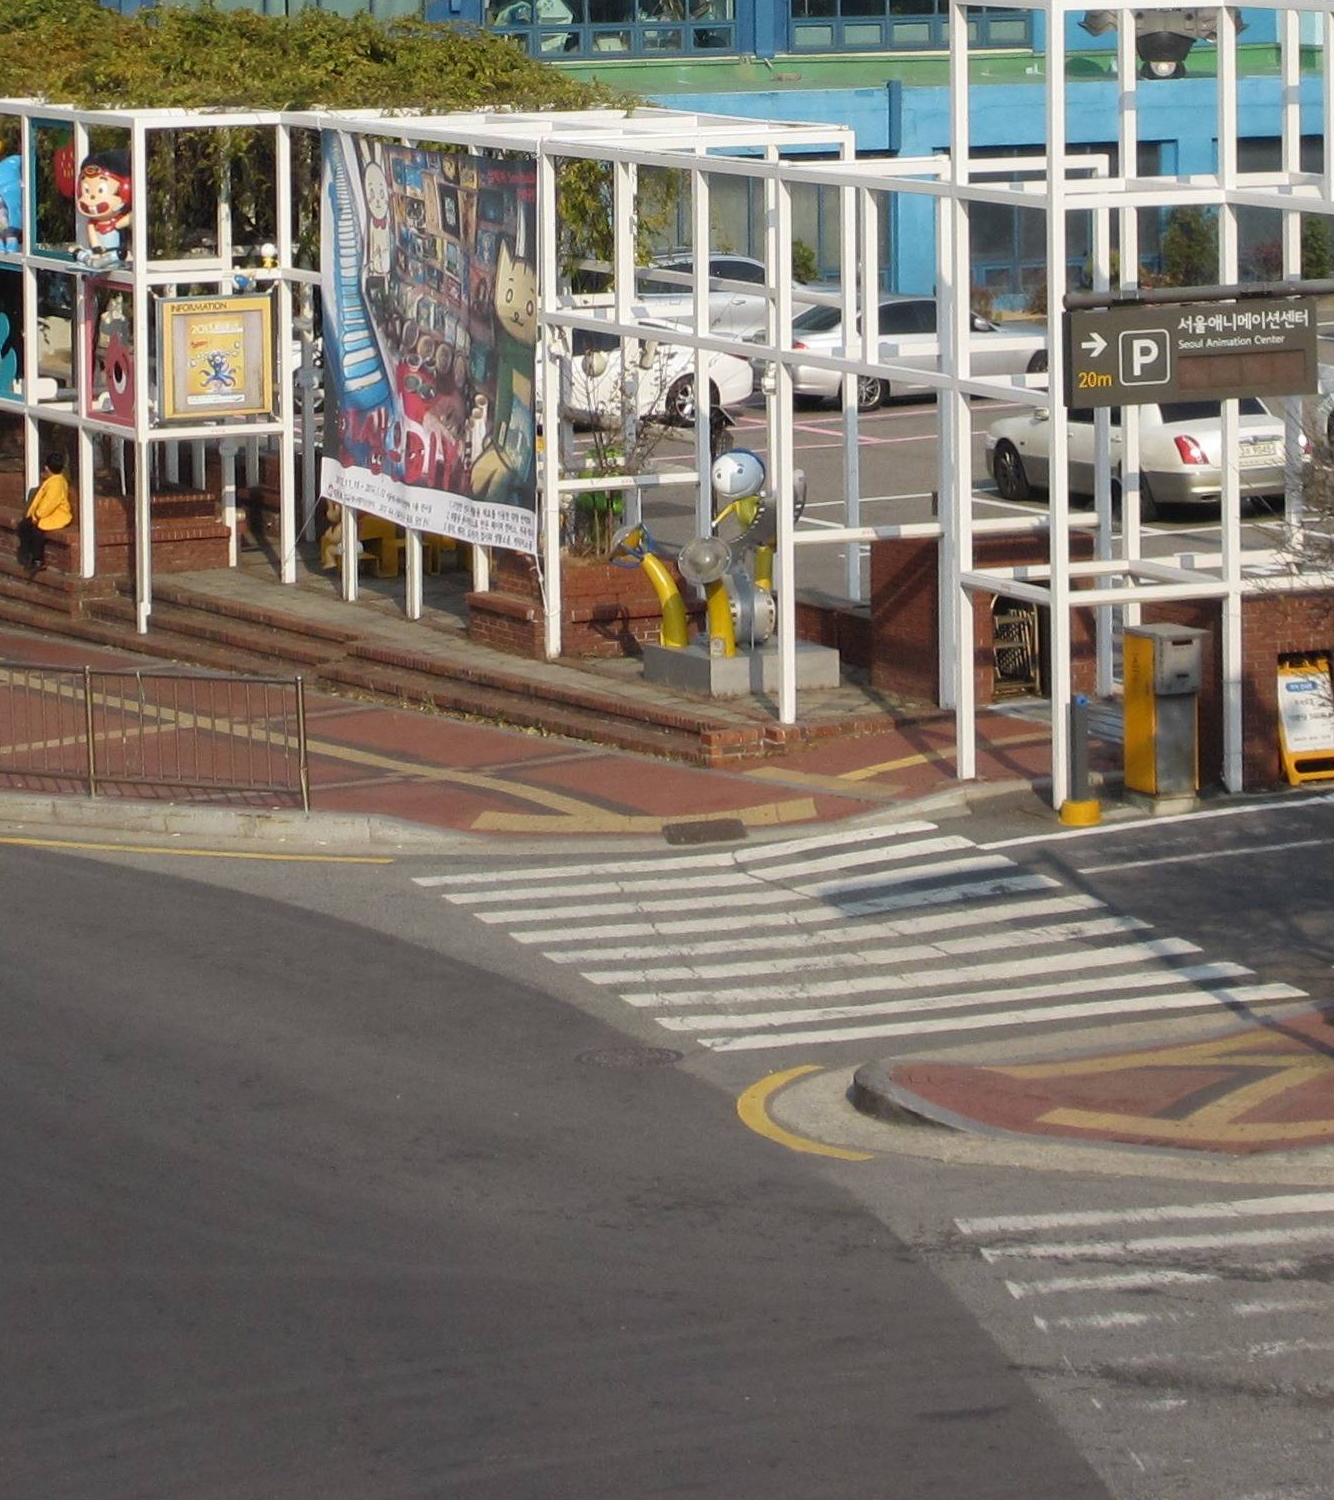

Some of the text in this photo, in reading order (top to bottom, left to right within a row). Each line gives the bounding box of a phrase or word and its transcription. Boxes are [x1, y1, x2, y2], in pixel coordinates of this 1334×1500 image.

[171, 301, 227, 313] INFORMATION
[1177, 309, 1309, 334] 서울애니메이션센터
[1178, 334, 1286, 350] Seoul Animation Center
[1132, 339, 1160, 376] P
[1078, 371, 1113, 389] 20m
